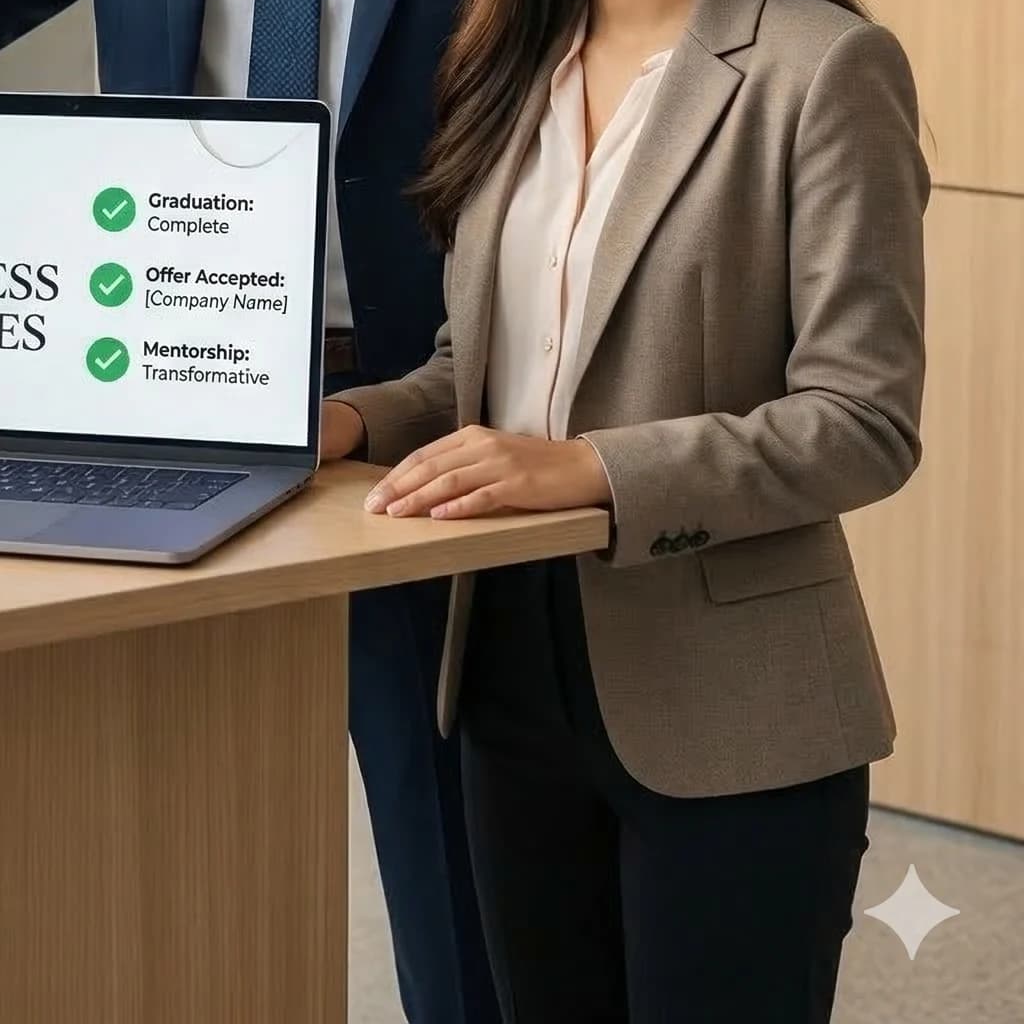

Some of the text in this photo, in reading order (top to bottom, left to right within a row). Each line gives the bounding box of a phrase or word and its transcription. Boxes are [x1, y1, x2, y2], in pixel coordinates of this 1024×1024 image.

[148, 193, 254, 212] Graduation:
[148, 217, 230, 235] Complete
[146, 267, 285, 290] Offer Accepted:
[145, 290, 287, 314] [Company Name]
[144, 341, 249, 362] Mentorship:
[143, 365, 270, 386] Transformative
